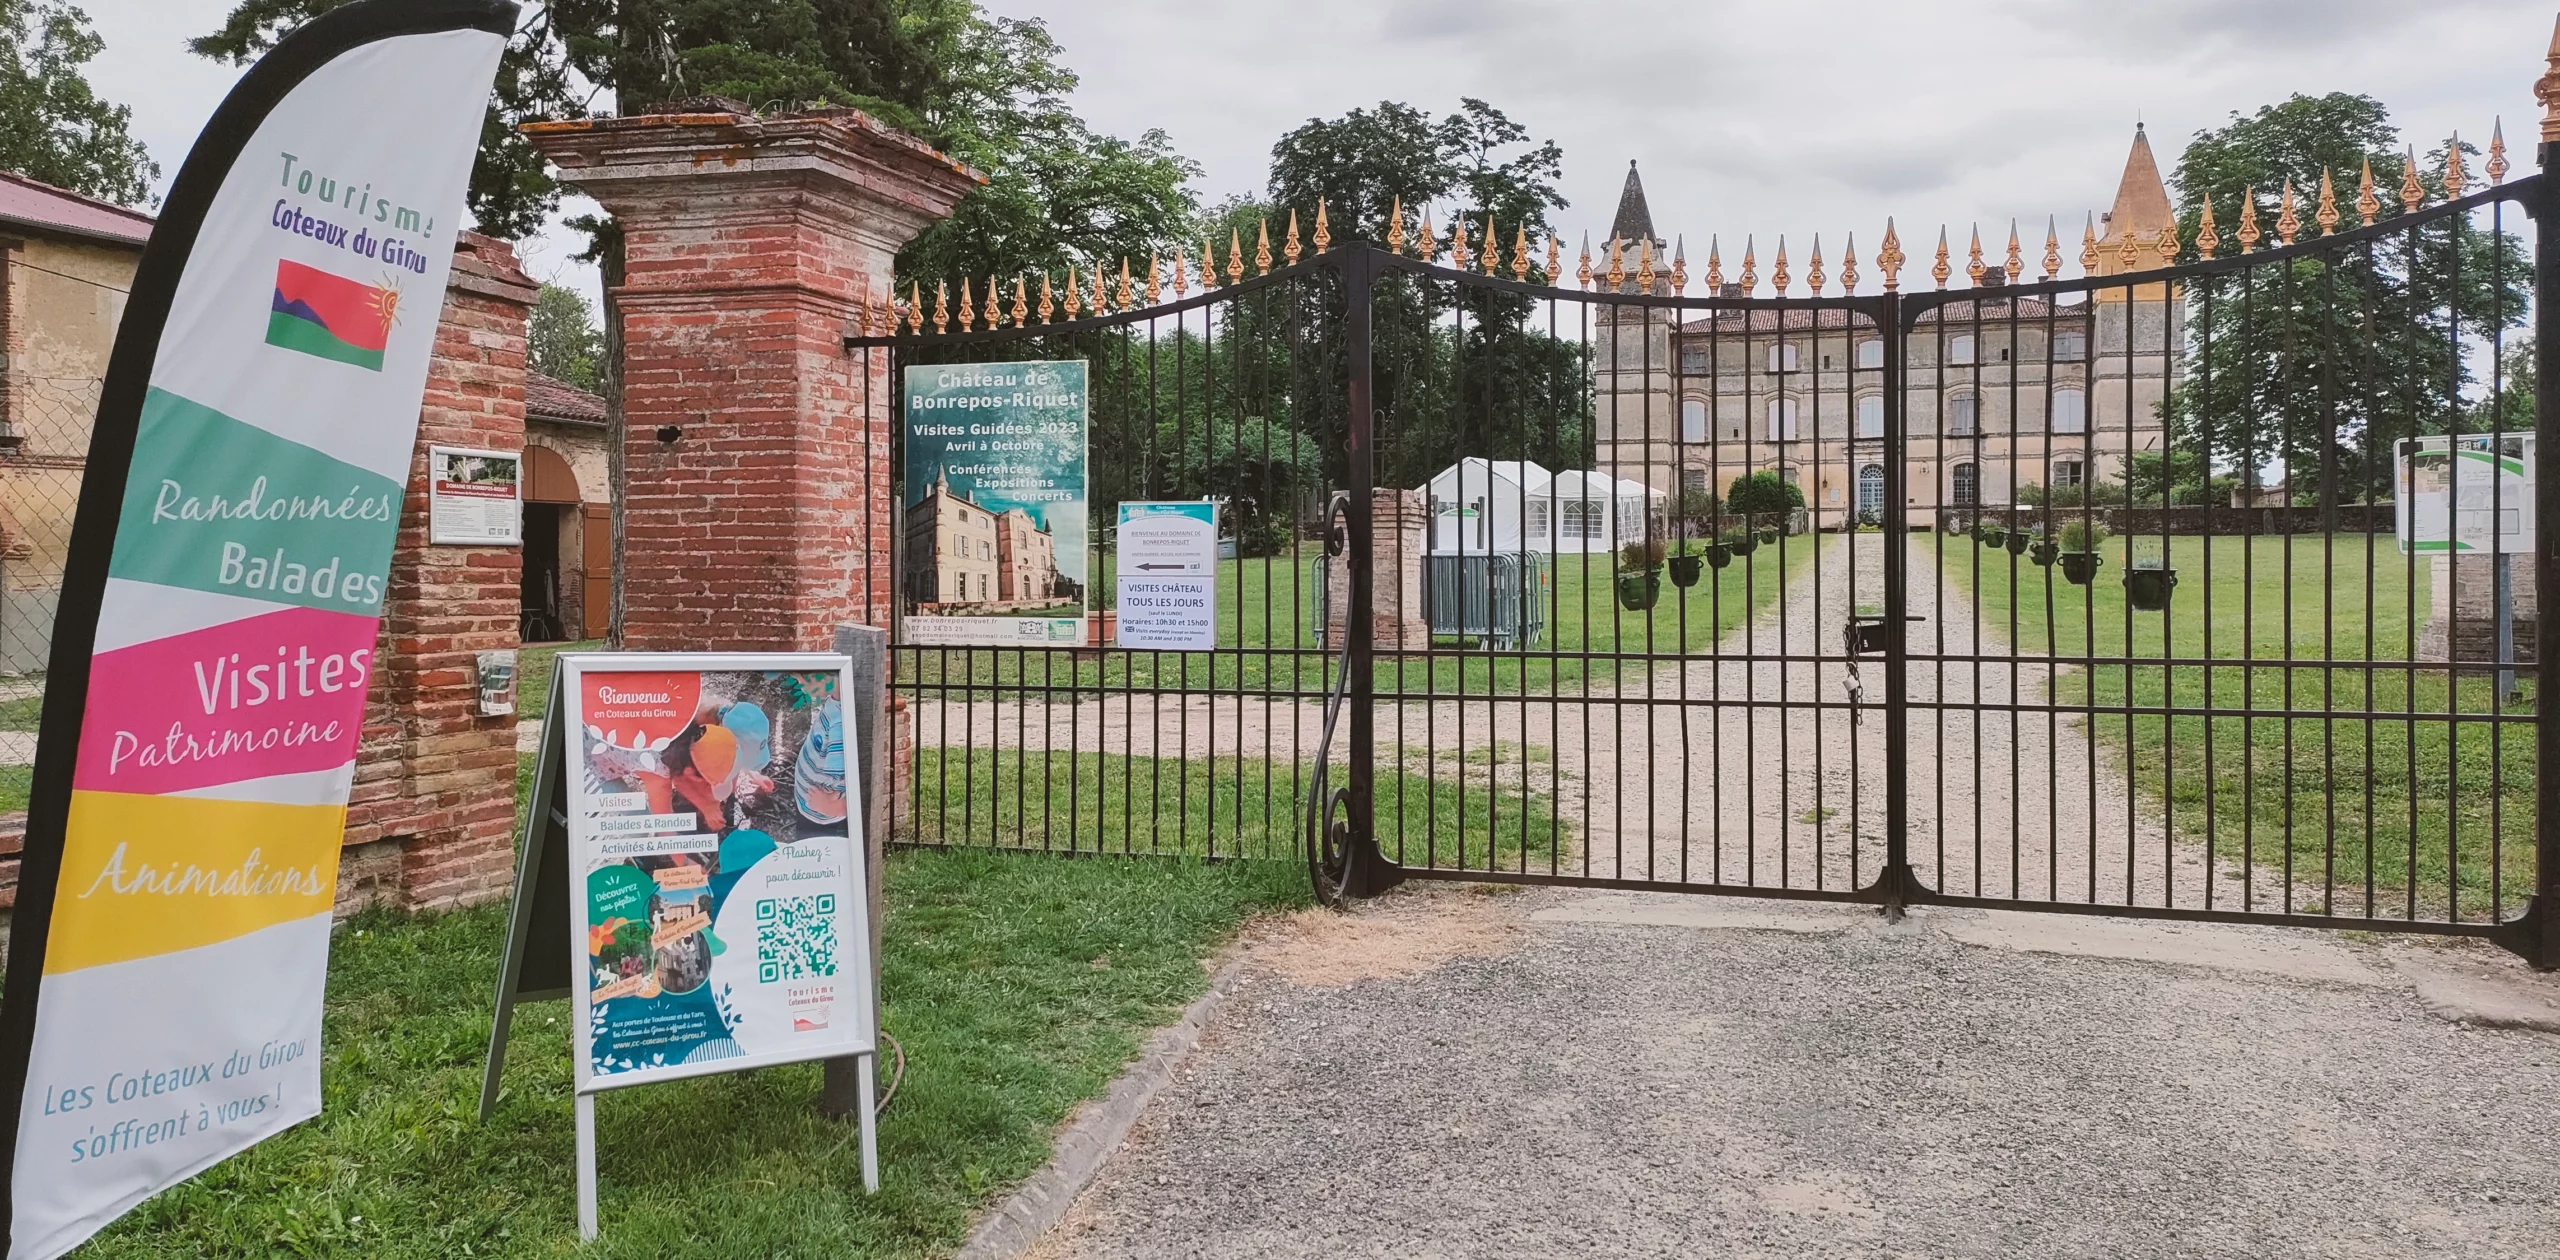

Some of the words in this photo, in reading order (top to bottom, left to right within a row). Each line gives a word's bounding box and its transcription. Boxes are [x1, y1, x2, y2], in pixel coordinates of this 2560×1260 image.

[272, 199, 348, 249] Coteaux
[353, 227, 377, 259] du
[938, 373, 1016, 388] Château
[1025, 370, 1048, 386] de
[912, 391, 1078, 411] Bonrepos-Riquet
[913, 424, 965, 436] Visites
[970, 421, 1033, 435] Guidées
[1038, 421, 1078, 434] 2023
[945, 441, 976, 451] Avril
[980, 440, 987, 451] à
[991, 440, 1045, 451] Octobre
[949, 464, 1031, 475] Conférences
[975, 478, 1054, 489] Expositions
[152, 475, 390, 525] Randonnées
[1012, 491, 1073, 501] Concerts
[217, 541, 381, 605] Balades
[1128, 584, 1160, 592] VISITES
[1162, 583, 1203, 593] CHÂTEAU
[1127, 598, 1153, 606] TOUS
[1155, 598, 1171, 607] LES
[1173, 599, 1204, 607] JOURS
[194, 645, 370, 715] Visites
[598, 686, 671, 705] Bienvenue
[606, 709, 640, 718] Coteaux
[641, 708, 653, 718] du
[653, 708, 677, 718] Girou
[109, 720, 343, 775] Patrimoine
[599, 796, 632, 808] Visites
[600, 820, 641, 831] Balades
[644, 818, 652, 829] &
[654, 817, 692, 828] Randos
[601, 842, 644, 854] Activités
[646, 841, 655, 852] &
[656, 837, 713, 851] Animations
[782, 846, 822, 862] Flashez
[77, 842, 326, 899] Animations
[765, 873, 790, 888] pour
[791, 868, 836, 881] découvrir
[838, 865, 841, 877] !
[595, 883, 638, 902] Découvrez
[787, 985, 834, 997] Tourisme
[788, 997, 811, 1006] Coteaux
[819, 995, 834, 1003] Girou
[624, 1018, 643, 1027] portes
[651, 1015, 676, 1023] Toulouse
[612, 1030, 708, 1049] www.cc-coteaux-du-girou.fr
[44, 1085, 95, 1116] Les
[106, 1061, 215, 1104] Coteaux
[222, 1049, 252, 1079] du
[258, 1038, 306, 1070] Girou
[71, 1109, 190, 1163] s'offrent
[197, 1102, 210, 1131] à
[217, 1093, 270, 1125] vous
[274, 1082, 282, 1109] !
